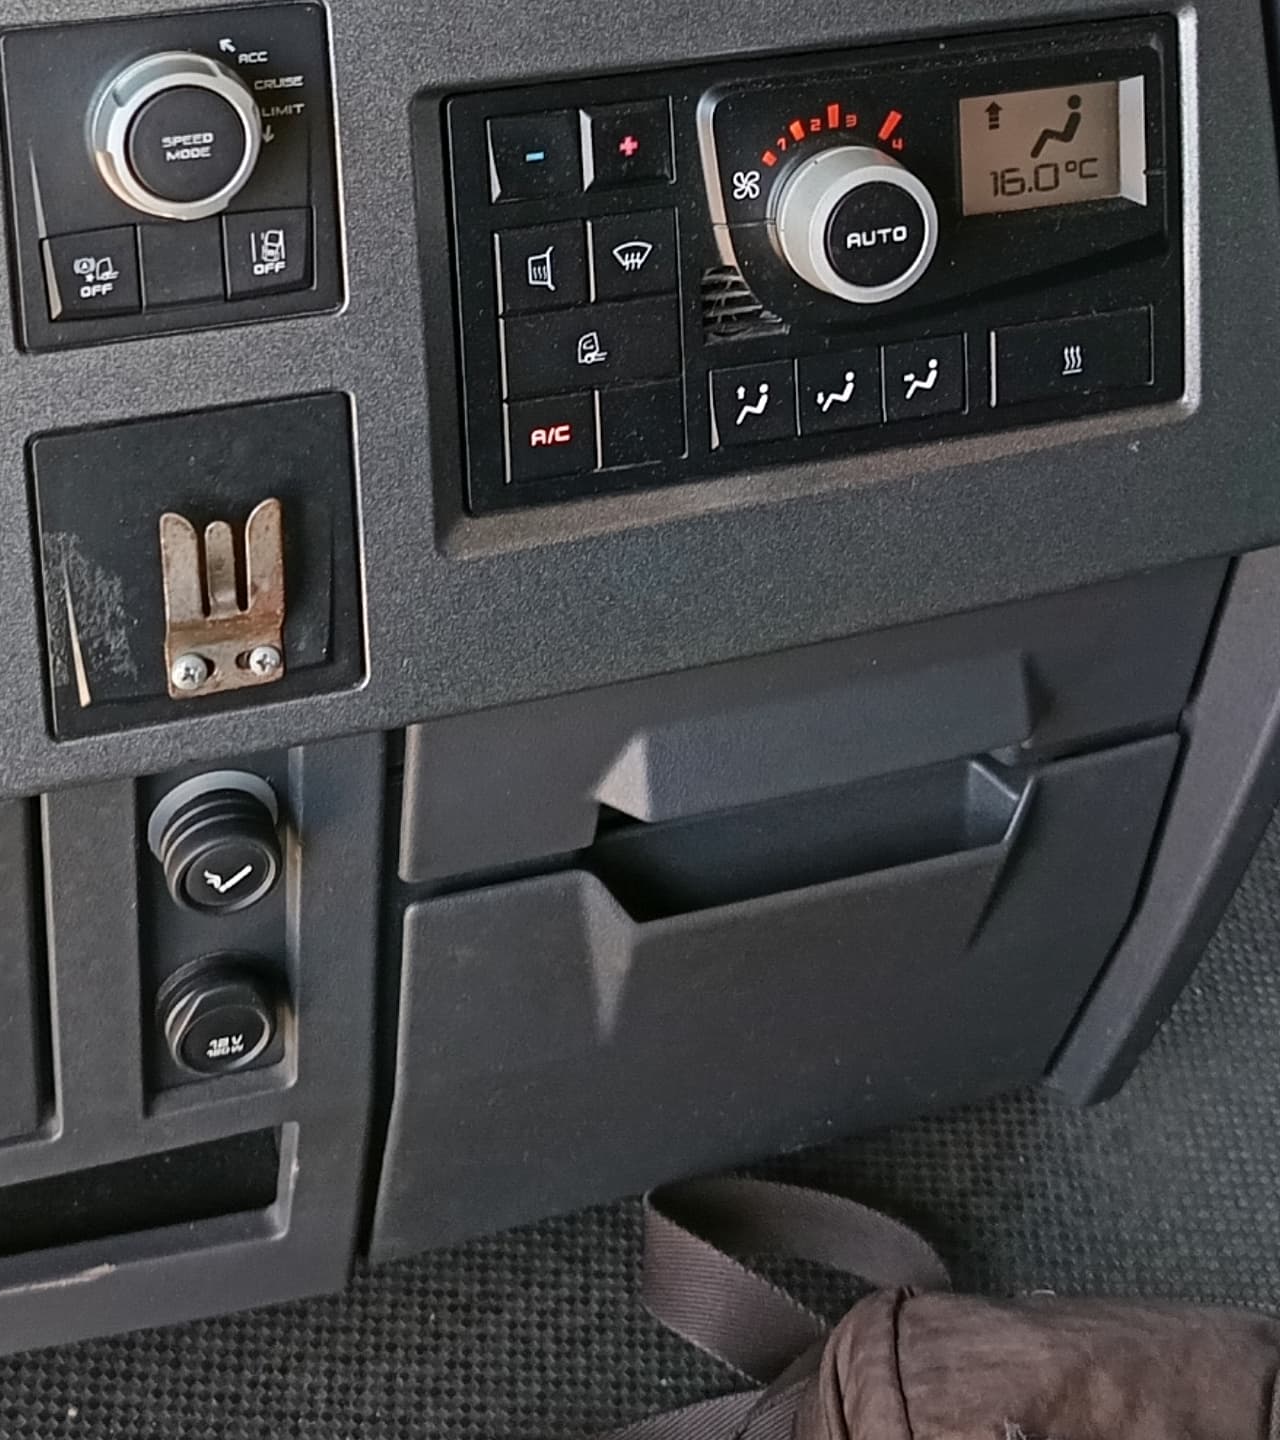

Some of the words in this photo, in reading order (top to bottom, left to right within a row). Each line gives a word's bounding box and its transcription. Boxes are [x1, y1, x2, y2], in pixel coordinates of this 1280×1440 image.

[238, 50, 268, 64] ACC
[254, 75, 304, 91] CRUISE
[262, 103, 305, 117] LIMIT
[810, 118, 821, 132] 2
[845, 114, 857, 128] 3
[162, 132, 214, 147] SPEED
[777, 137, 787, 151] 1
[891, 137, 903, 150] 4
[166, 146, 212, 162] MODE
[846, 225, 908, 249] AUTO
[253, 261, 286, 276] OFF
[80, 282, 113, 298] OFF
[531, 424, 570, 447] A/C
